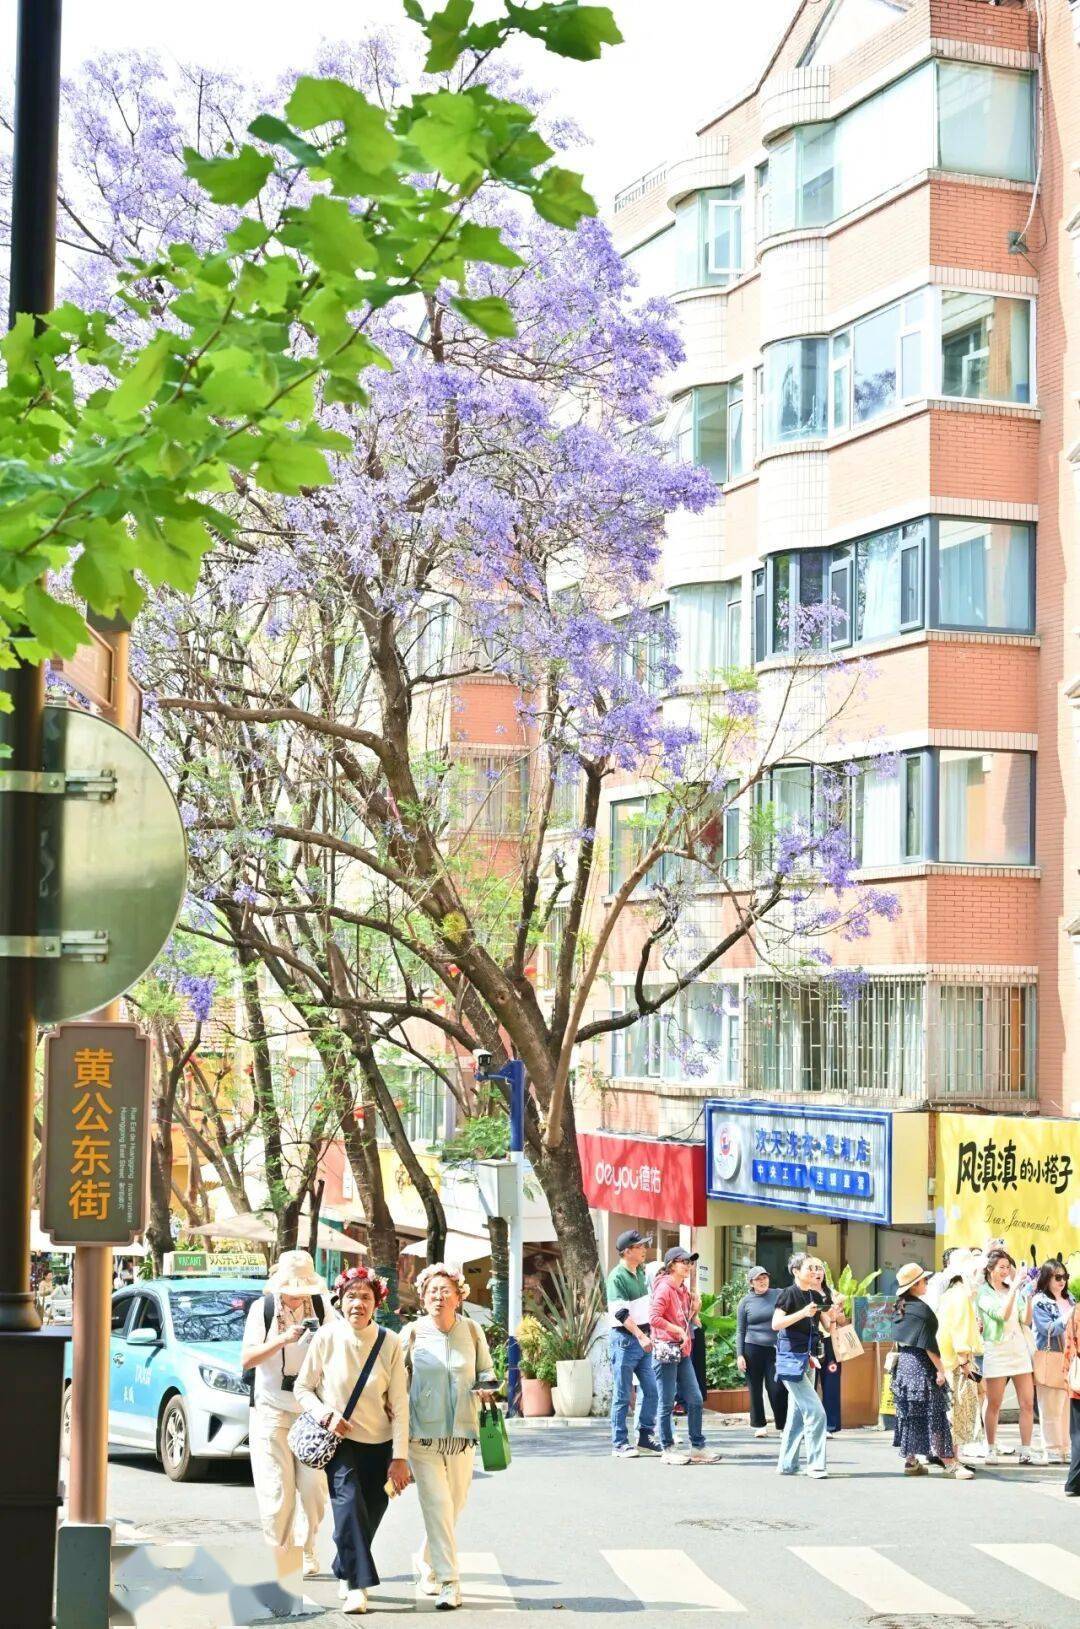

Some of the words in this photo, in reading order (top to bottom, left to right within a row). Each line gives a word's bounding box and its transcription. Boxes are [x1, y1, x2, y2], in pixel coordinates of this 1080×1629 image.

[130, 1107, 138, 1120] Rue
[69, 1048, 114, 1220] 黄公东街
[130, 1133, 136, 1142] de
[118, 1160, 126, 1179] Street
[757, 1163, 800, 1181] 中央工厂
[640, 1164, 661, 1194] 德佑
